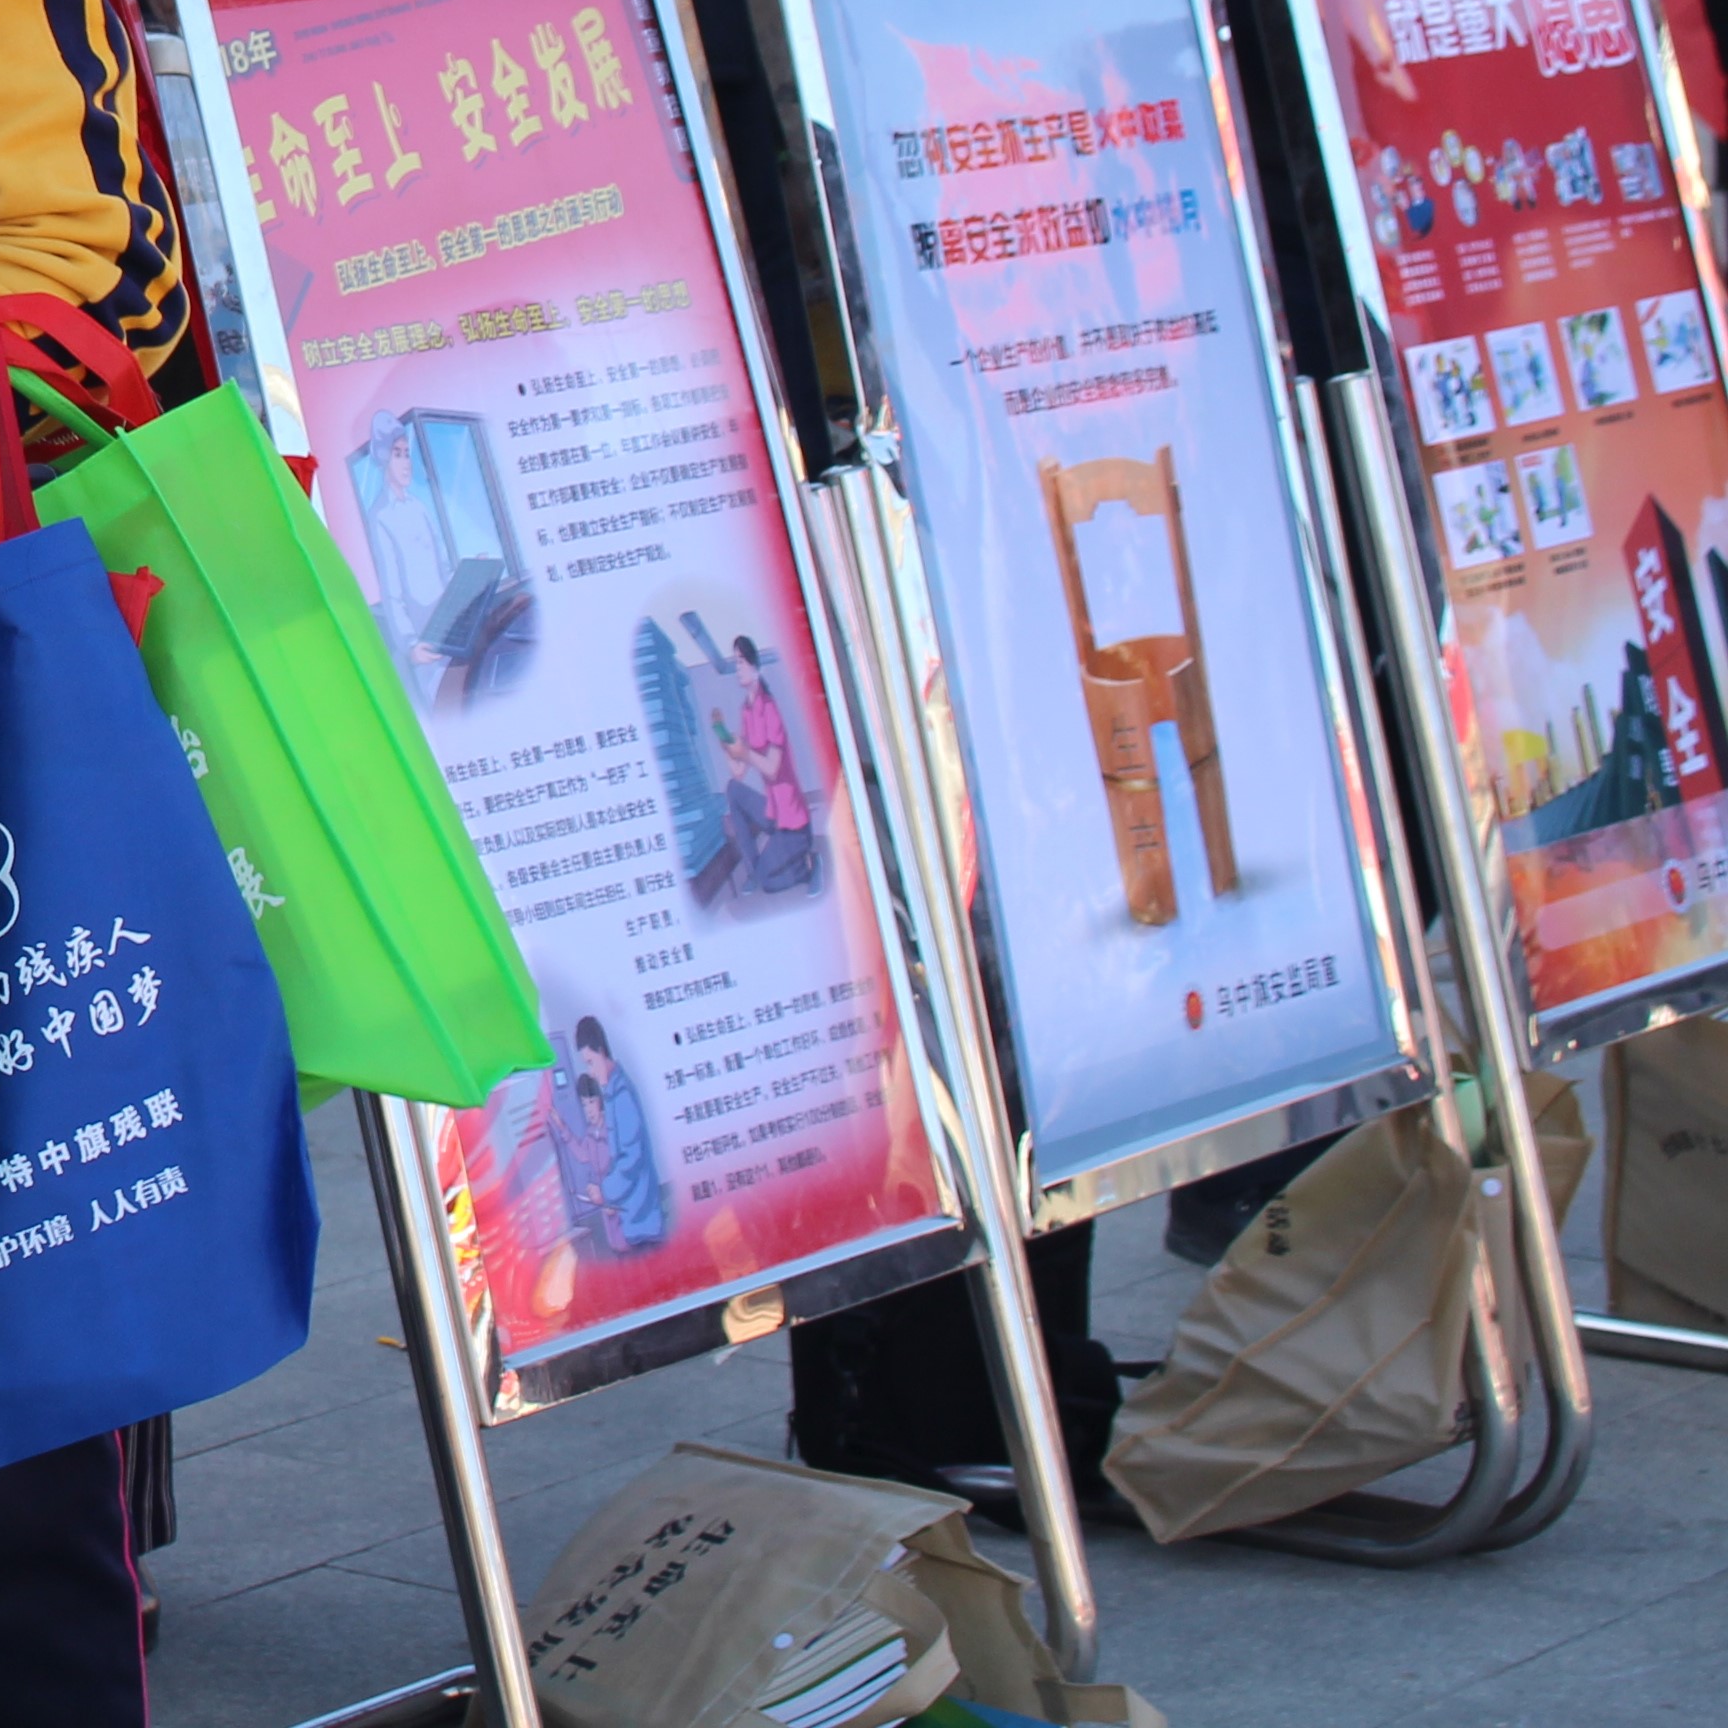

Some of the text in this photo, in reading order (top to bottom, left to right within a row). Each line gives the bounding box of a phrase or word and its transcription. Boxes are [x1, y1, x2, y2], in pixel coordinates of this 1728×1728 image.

[438, 7, 632, 163] 安全发展
[89, 1166, 189, 1232] 人人有责
